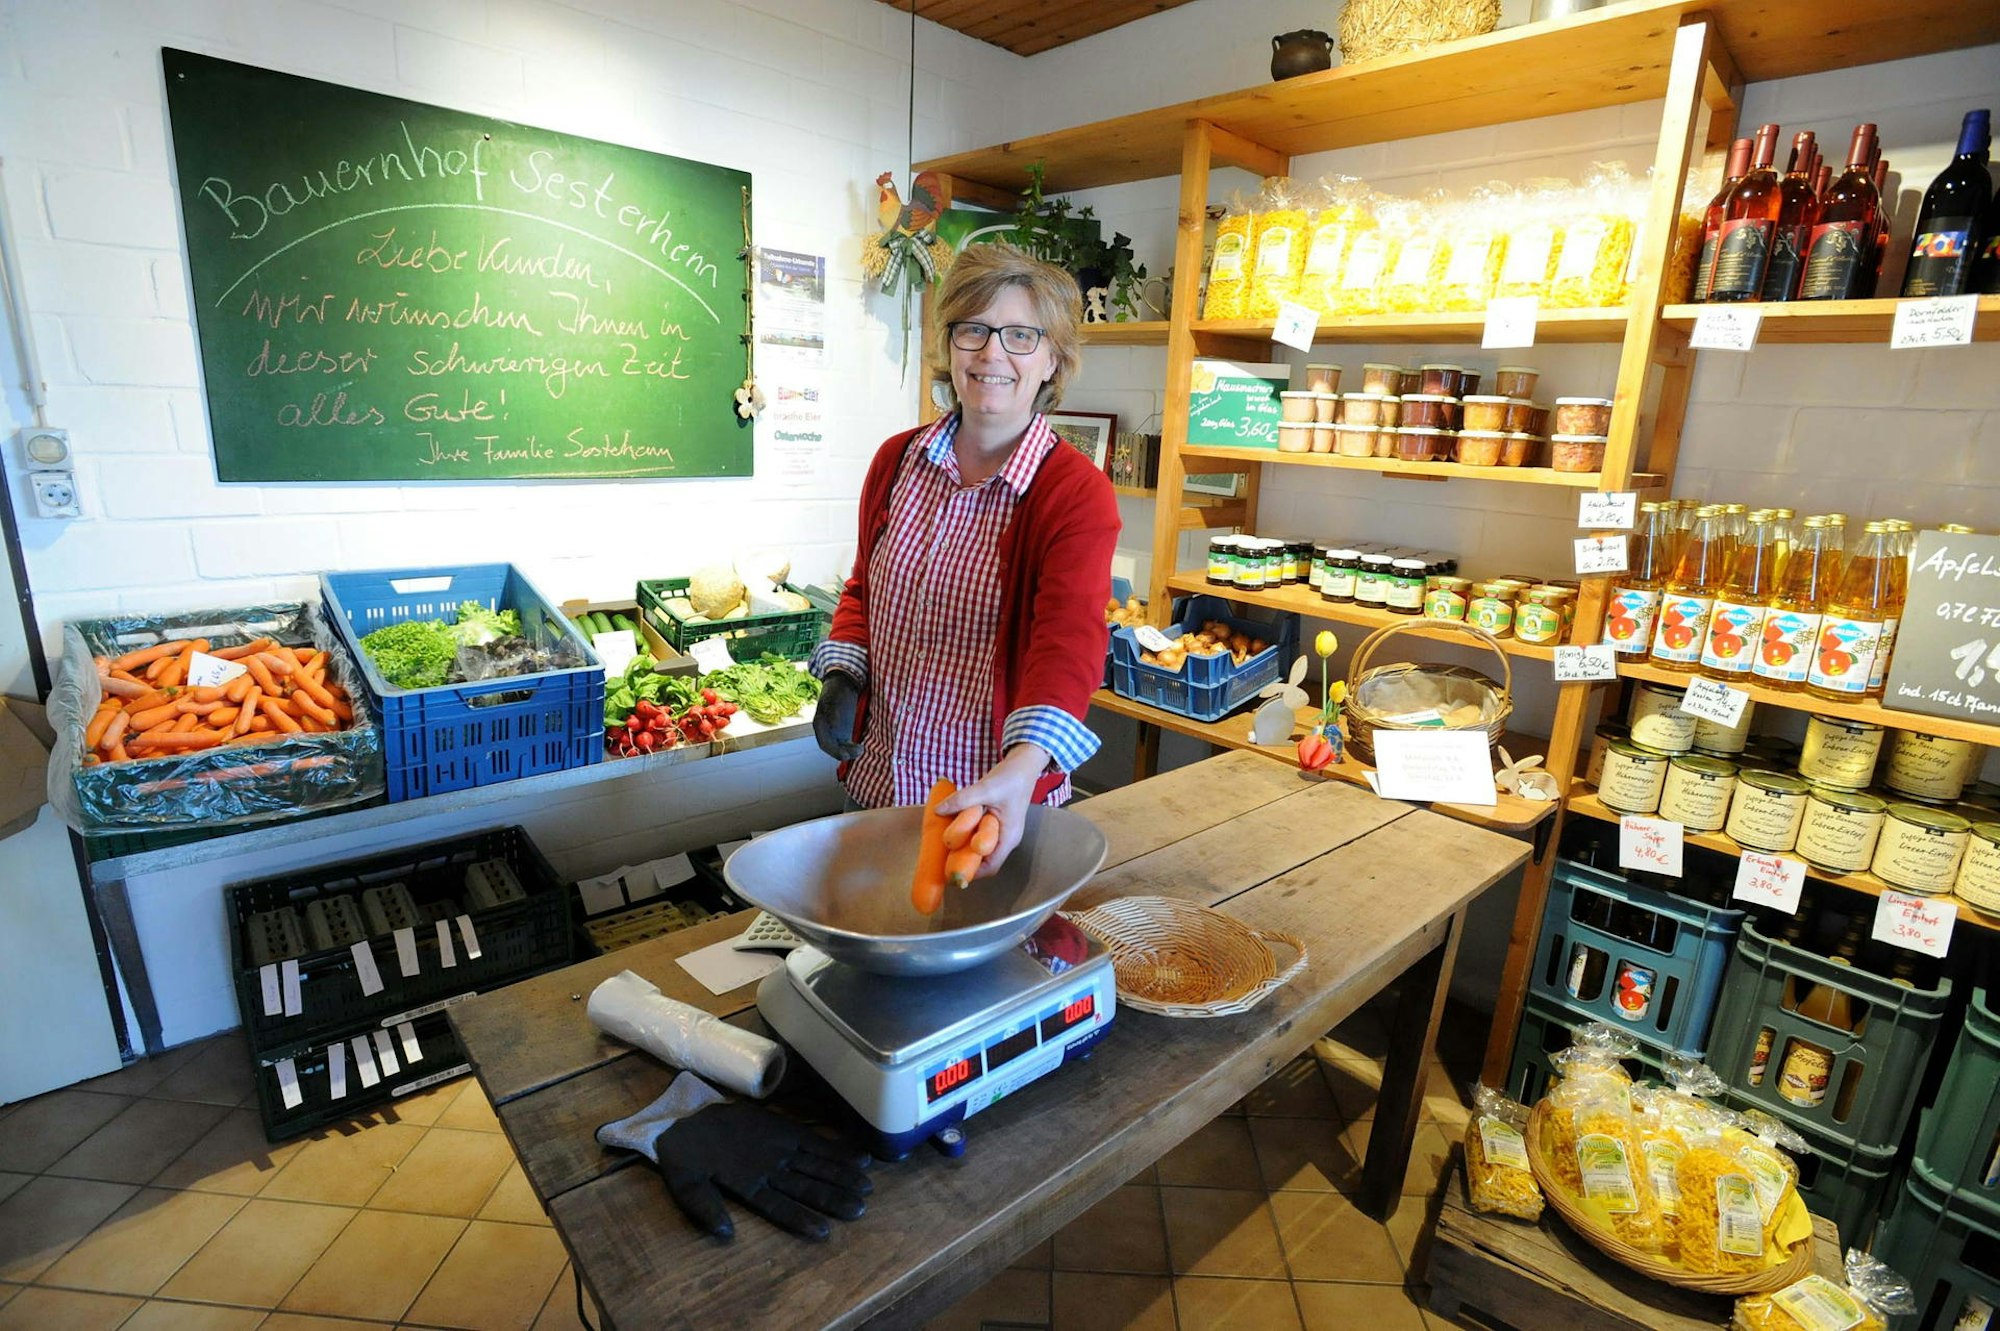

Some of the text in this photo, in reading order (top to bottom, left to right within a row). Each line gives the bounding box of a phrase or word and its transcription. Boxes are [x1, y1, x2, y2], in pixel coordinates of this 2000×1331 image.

[199, 121, 720, 289] Bauernhof Sesterhenn
[356, 226, 613, 293] Liebe Kunden,
[243, 277, 692, 342] Wir wünschen Ihnen in
[247, 339, 692, 399] dieser schwierigen Zeit
[277, 387, 510, 429] alles Gute!
[416, 431, 472, 467] Ihre
[477, 433, 556, 463] Familie
